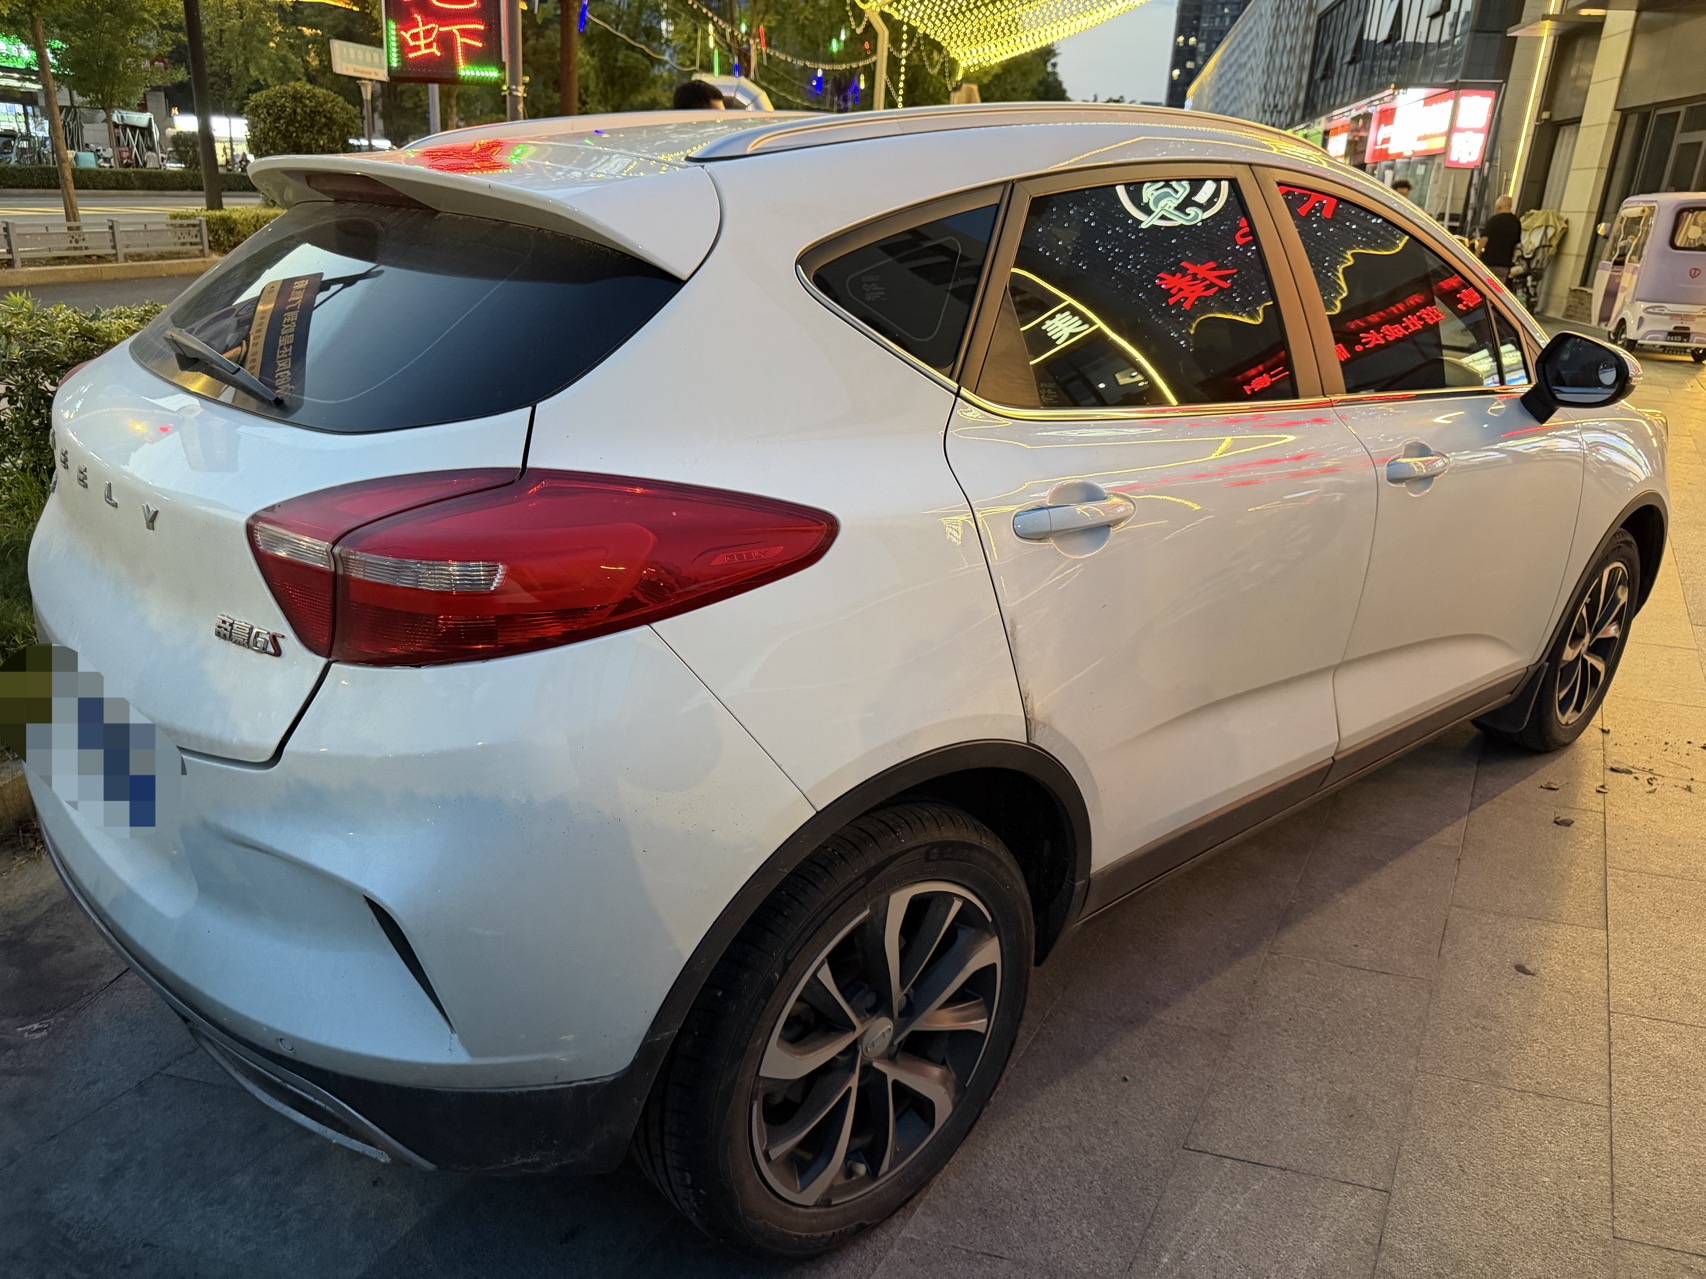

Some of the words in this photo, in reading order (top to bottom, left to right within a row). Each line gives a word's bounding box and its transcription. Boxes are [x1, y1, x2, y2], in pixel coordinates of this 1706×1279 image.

[399, 0, 485, 69] 虾
[49, 428, 160, 530] EELY
[725, 550, 768, 562] GEELY
